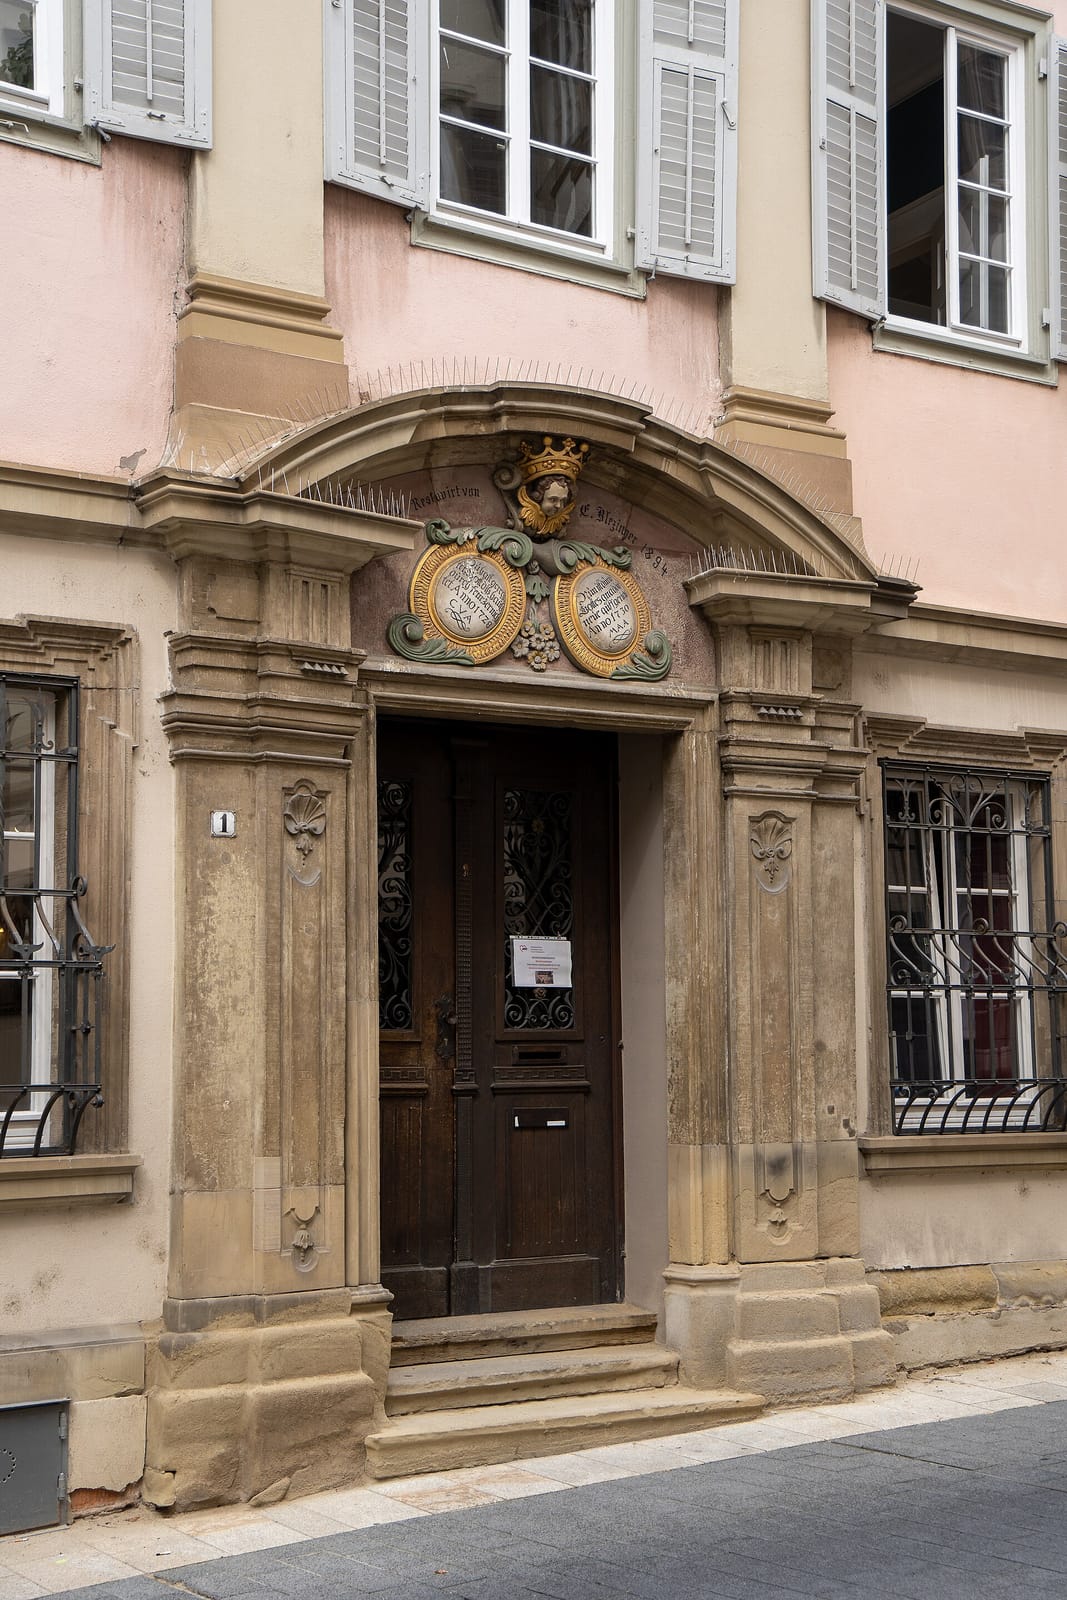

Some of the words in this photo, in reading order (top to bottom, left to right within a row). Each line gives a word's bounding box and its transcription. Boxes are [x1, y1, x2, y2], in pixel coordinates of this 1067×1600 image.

[640, 543, 669, 577] 1894
[474, 606, 493, 629] 1728
[588, 616, 612, 638] Anno
[610, 604, 630, 622] 1730
[220, 813, 229, 833] 1
